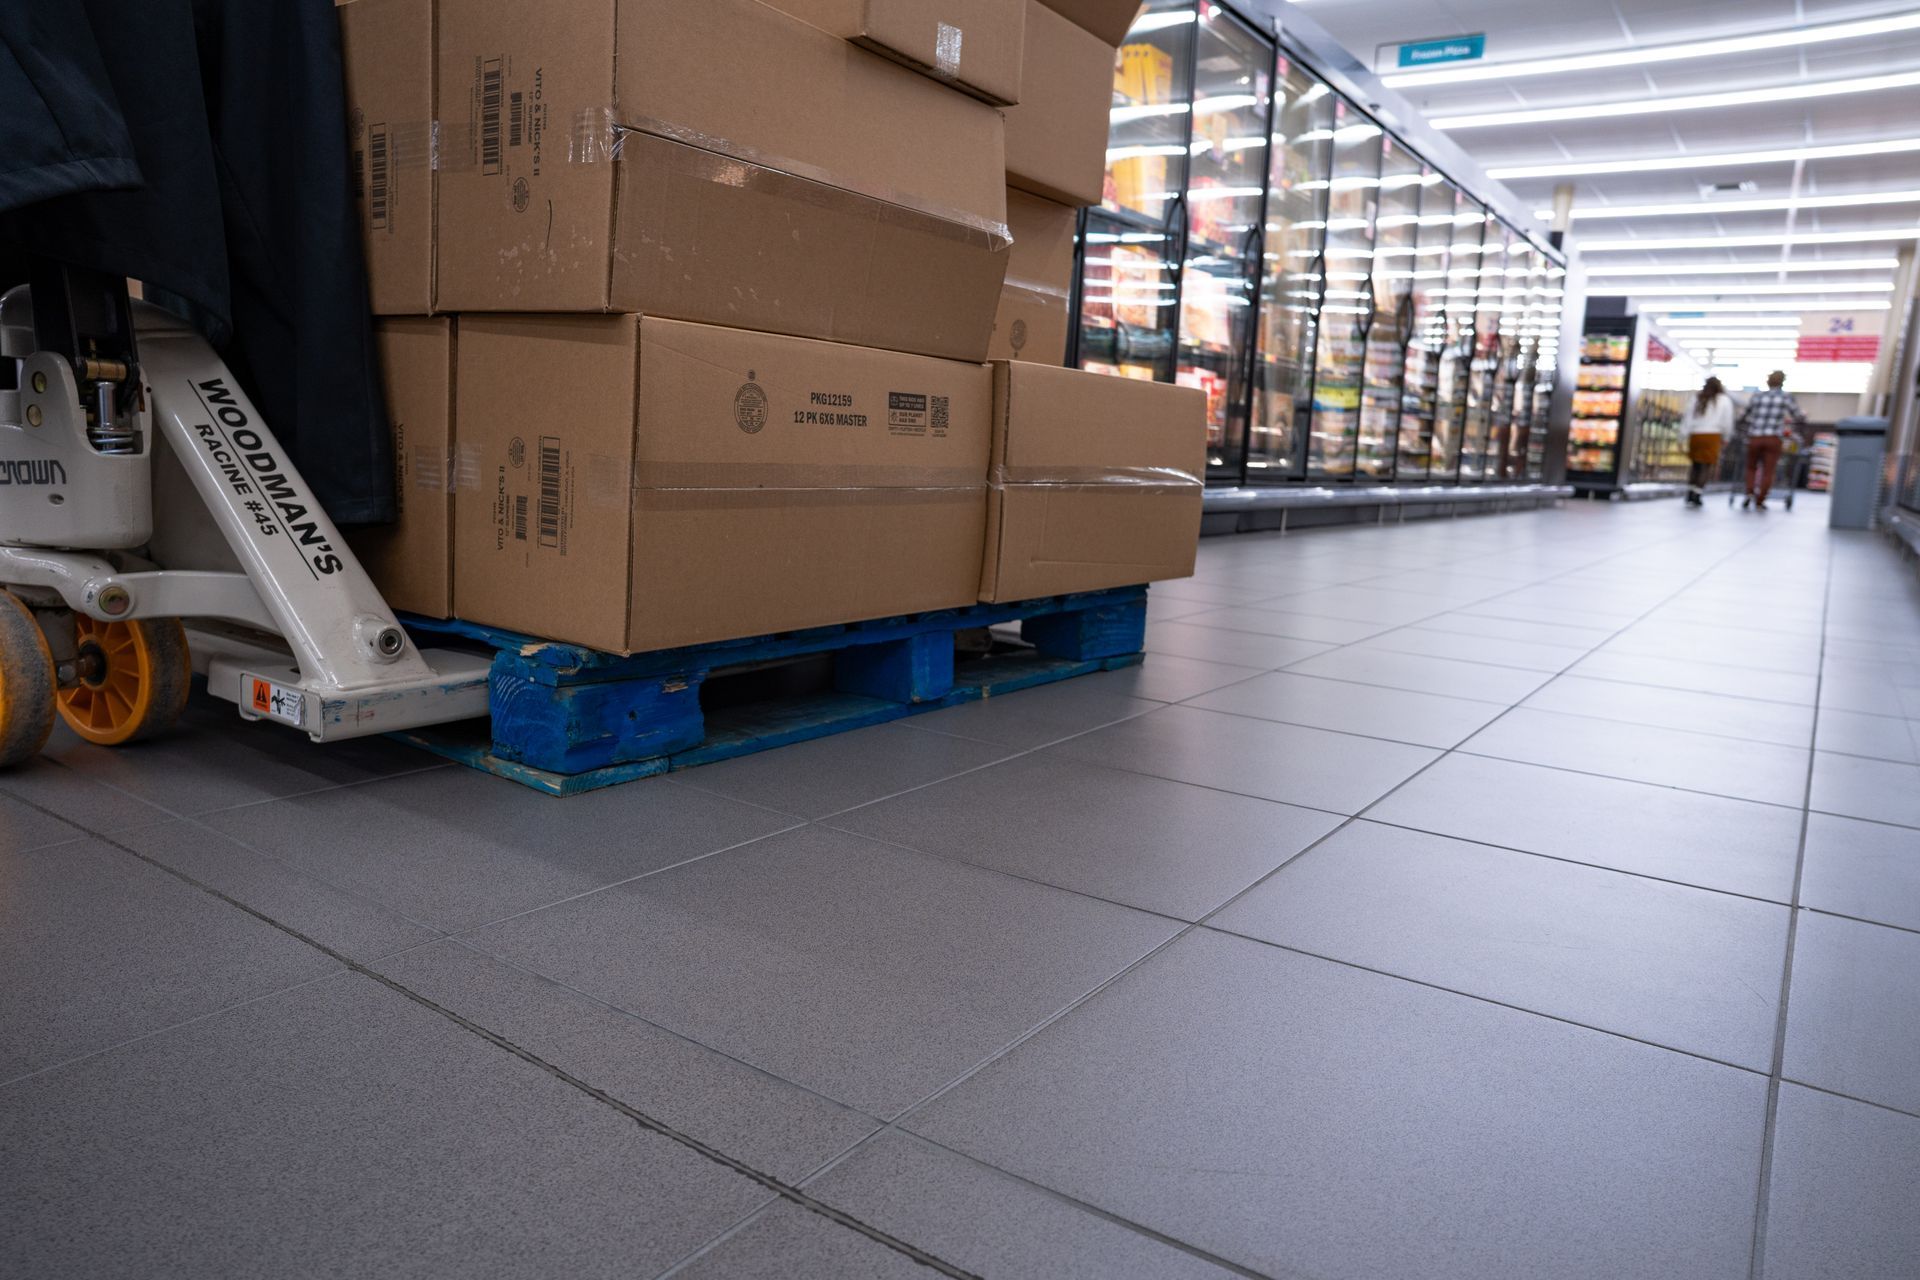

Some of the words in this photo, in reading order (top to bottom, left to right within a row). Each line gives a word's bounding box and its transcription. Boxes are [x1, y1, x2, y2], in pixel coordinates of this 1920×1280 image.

[534, 104, 541, 114] &
[533, 117, 541, 165] NICK'S
[533, 168, 540, 177] II
[1829, 317, 1854, 333] 24
[810, 391, 853, 407] PKG12159
[794, 411, 804, 424] 12
[806, 411, 818, 424] PK
[819, 412, 834, 425] 6X6
[836, 413, 867, 427] MASTER
[194, 423, 254, 497] RACINE
[245, 500, 279, 537] #45
[197, 376, 345, 577] WOODMAN'S
